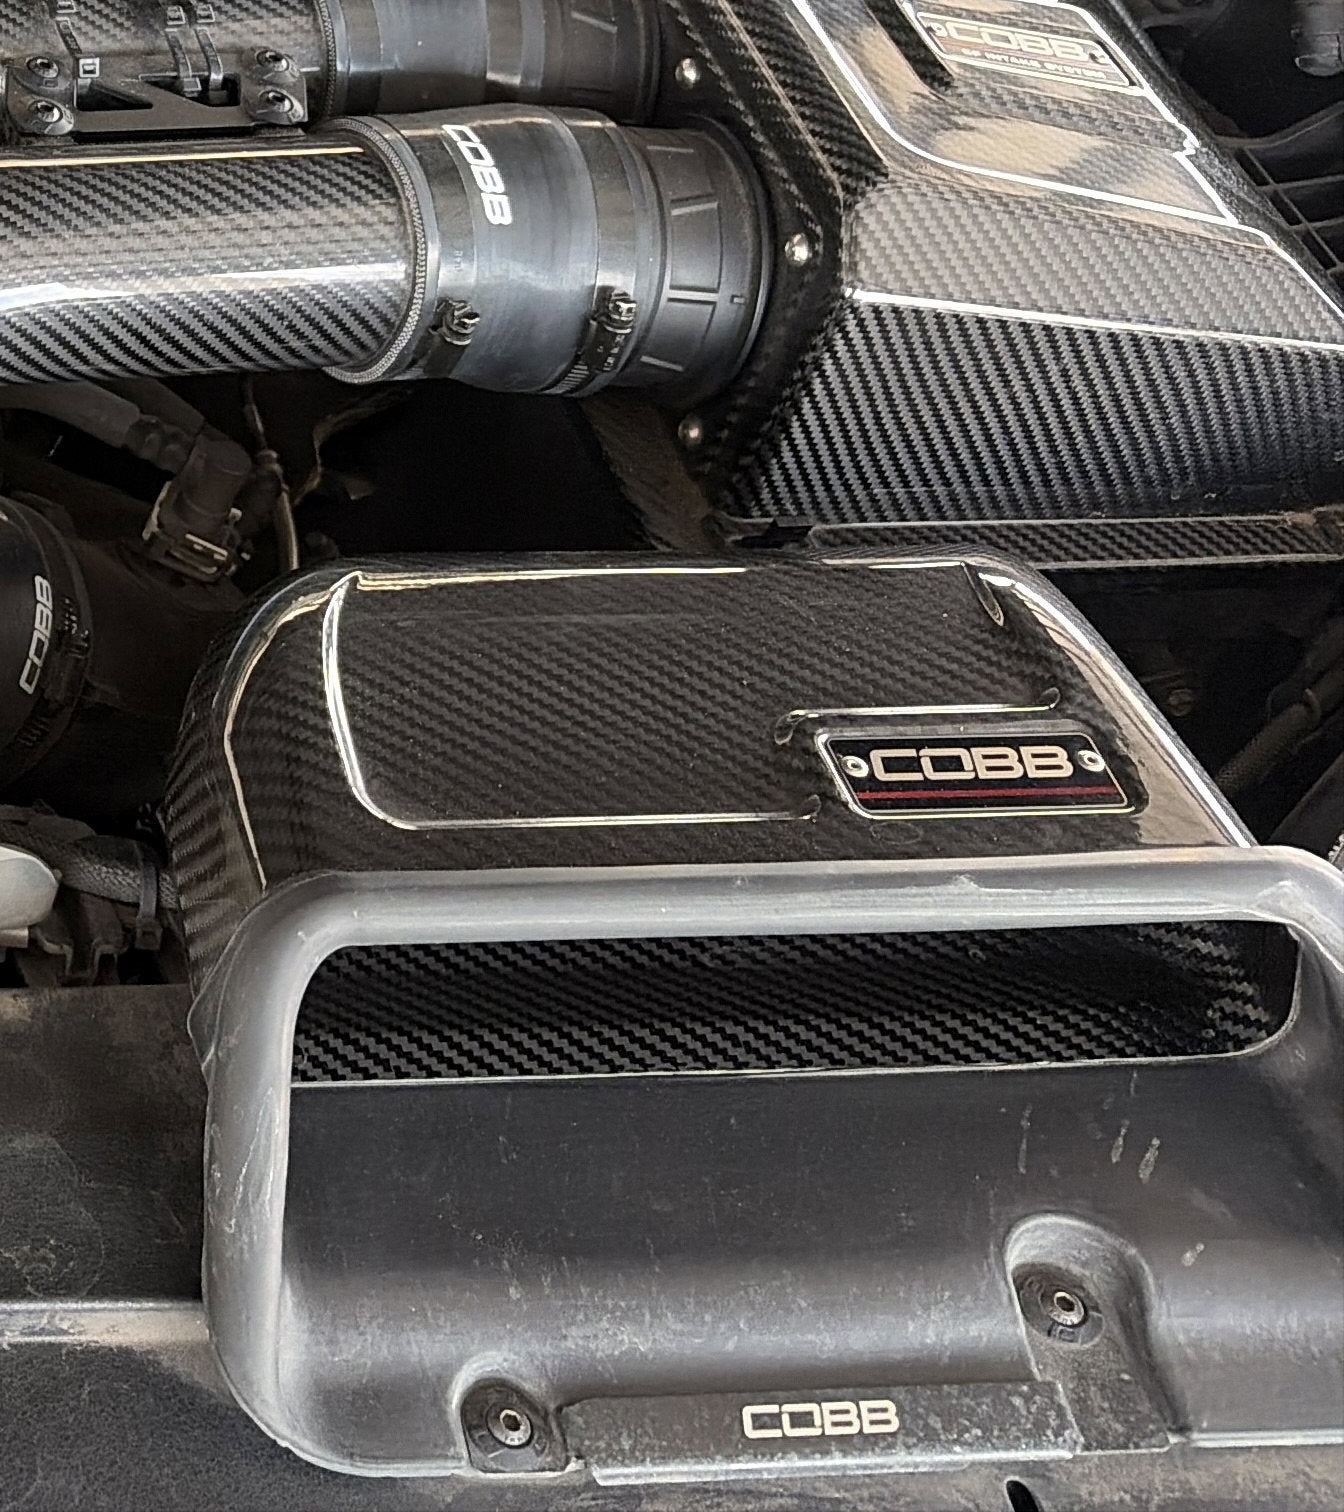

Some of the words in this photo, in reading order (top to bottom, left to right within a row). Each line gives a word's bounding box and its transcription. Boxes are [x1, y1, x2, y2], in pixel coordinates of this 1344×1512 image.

[946, 21, 1089, 62] COBB
[441, 124, 512, 226] COBB
[19, 574, 53, 694] COBB
[869, 745, 1074, 781] COBB
[742, 1399, 900, 1439] COBB
